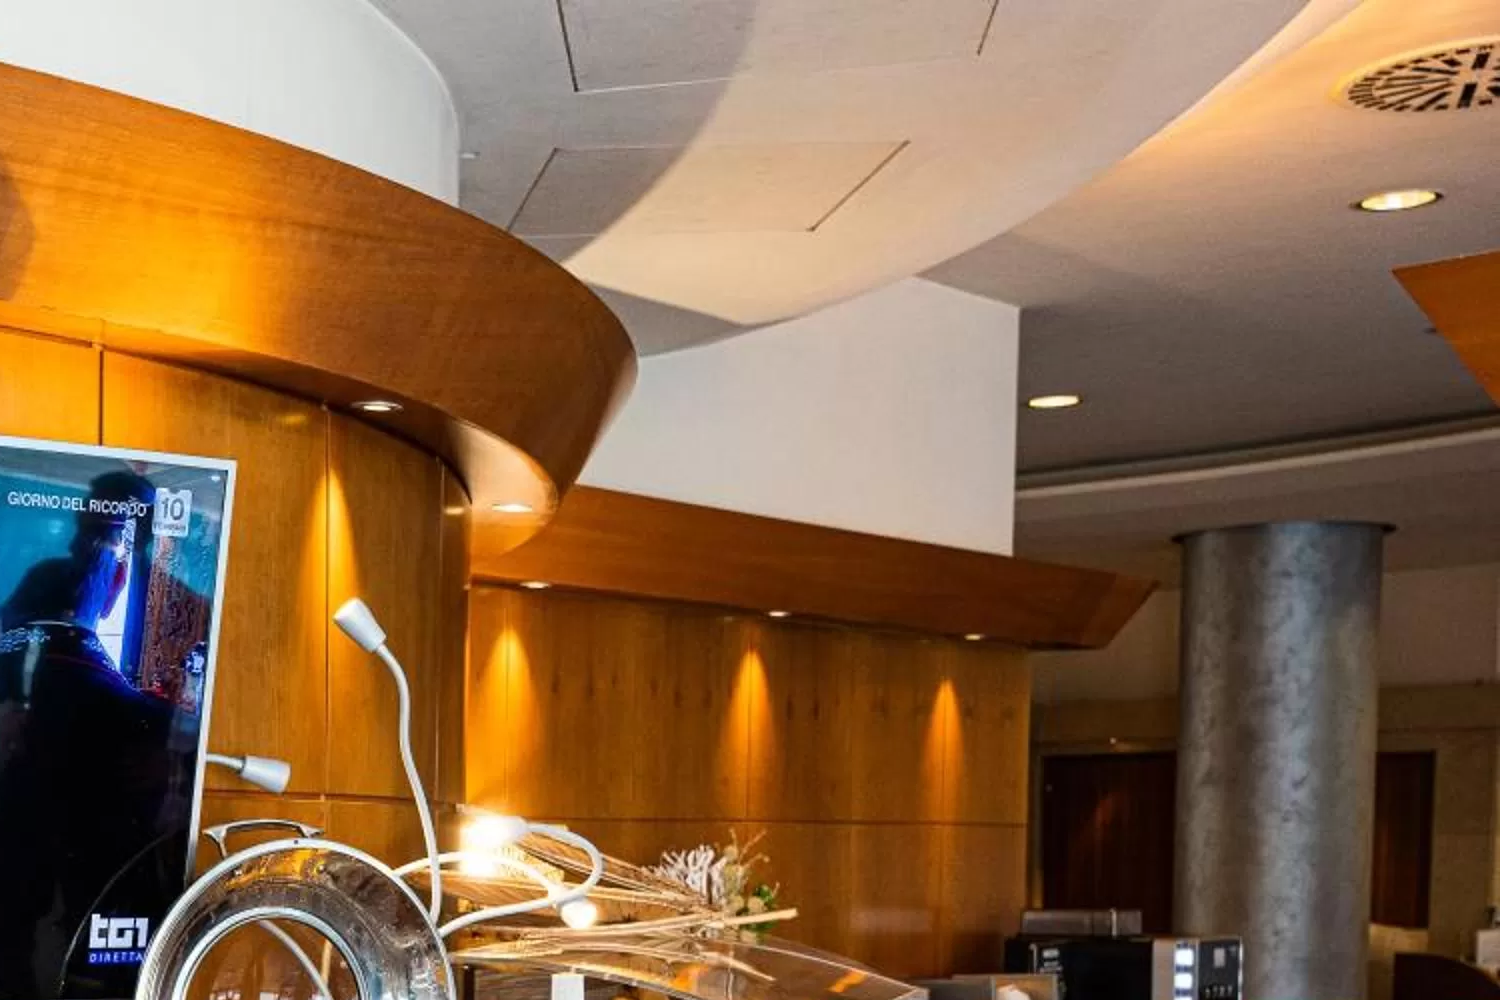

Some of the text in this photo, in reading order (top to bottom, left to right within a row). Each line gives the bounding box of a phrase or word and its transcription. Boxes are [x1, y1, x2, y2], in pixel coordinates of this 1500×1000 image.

[7, 491, 60, 509] GIORNO
[62, 497, 86, 511] DEL
[161, 497, 185, 520] 10
